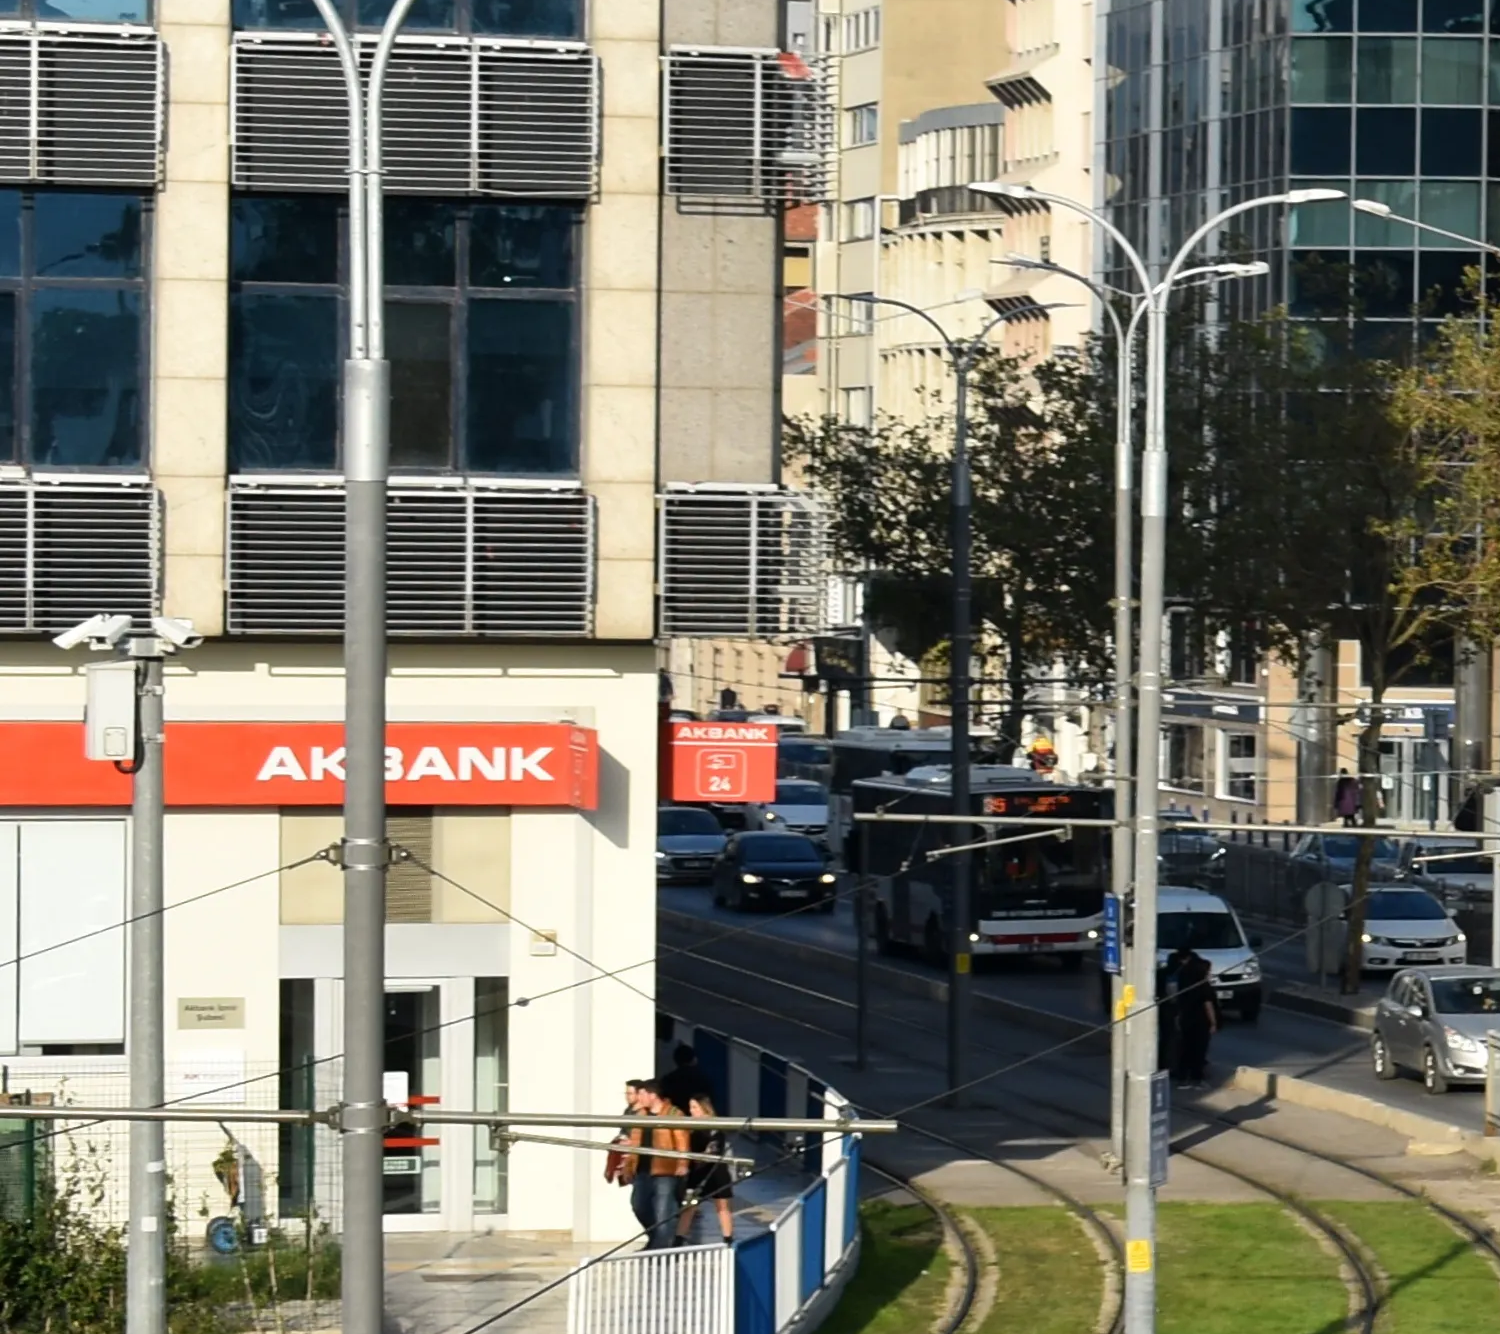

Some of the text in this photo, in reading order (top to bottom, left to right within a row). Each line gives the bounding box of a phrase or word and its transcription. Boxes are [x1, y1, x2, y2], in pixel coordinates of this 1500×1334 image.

[676, 726, 769, 740] AKBANK
[256, 745, 555, 782] AKBANK
[708, 775, 732, 792] 24
